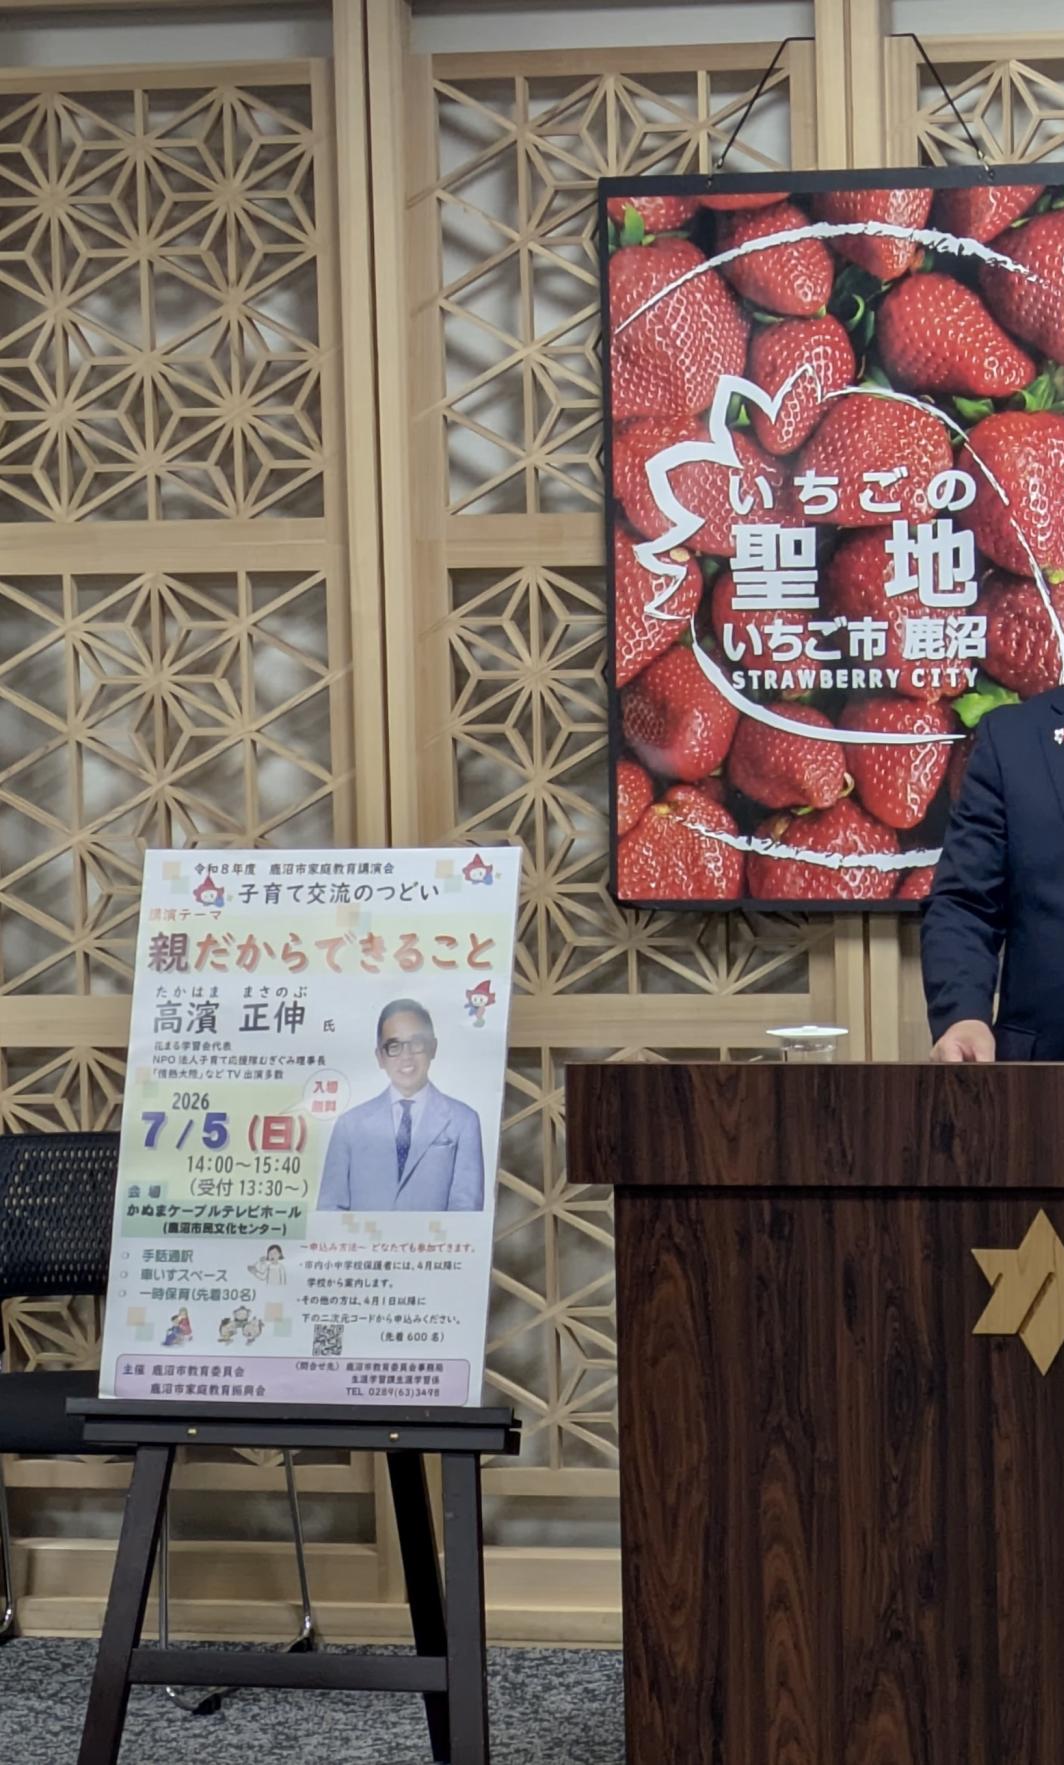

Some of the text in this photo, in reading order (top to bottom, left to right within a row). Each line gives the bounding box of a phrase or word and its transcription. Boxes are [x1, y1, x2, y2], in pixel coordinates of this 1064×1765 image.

[728, 466, 977, 515] いちごの
[730, 518, 978, 610] 聖地
[723, 616, 988, 662] いちご市 鹿沼
[732, 668, 979, 690] STRAWBERRY CITY
[238, 881, 440, 905] 子育て交流のつどい
[148, 930, 497, 973] 親だからできること
[155, 986, 308, 998] たかはま まさのぶ
[153, 1000, 336, 1034] 高濱 正伸 氏
[152, 1055, 176, 1065] NPO
[227, 1070, 241, 1079] TV
[172, 1092, 210, 1110] 2026
[126, 1203, 302, 1219] かぬまケーブルテレビホール
[142, 1248, 194, 1263] 手話通訳
[140, 1268, 228, 1282] 車いすスペース
[406, 1332, 428, 1342] 600
[345, 1387, 363, 1396] TEL
